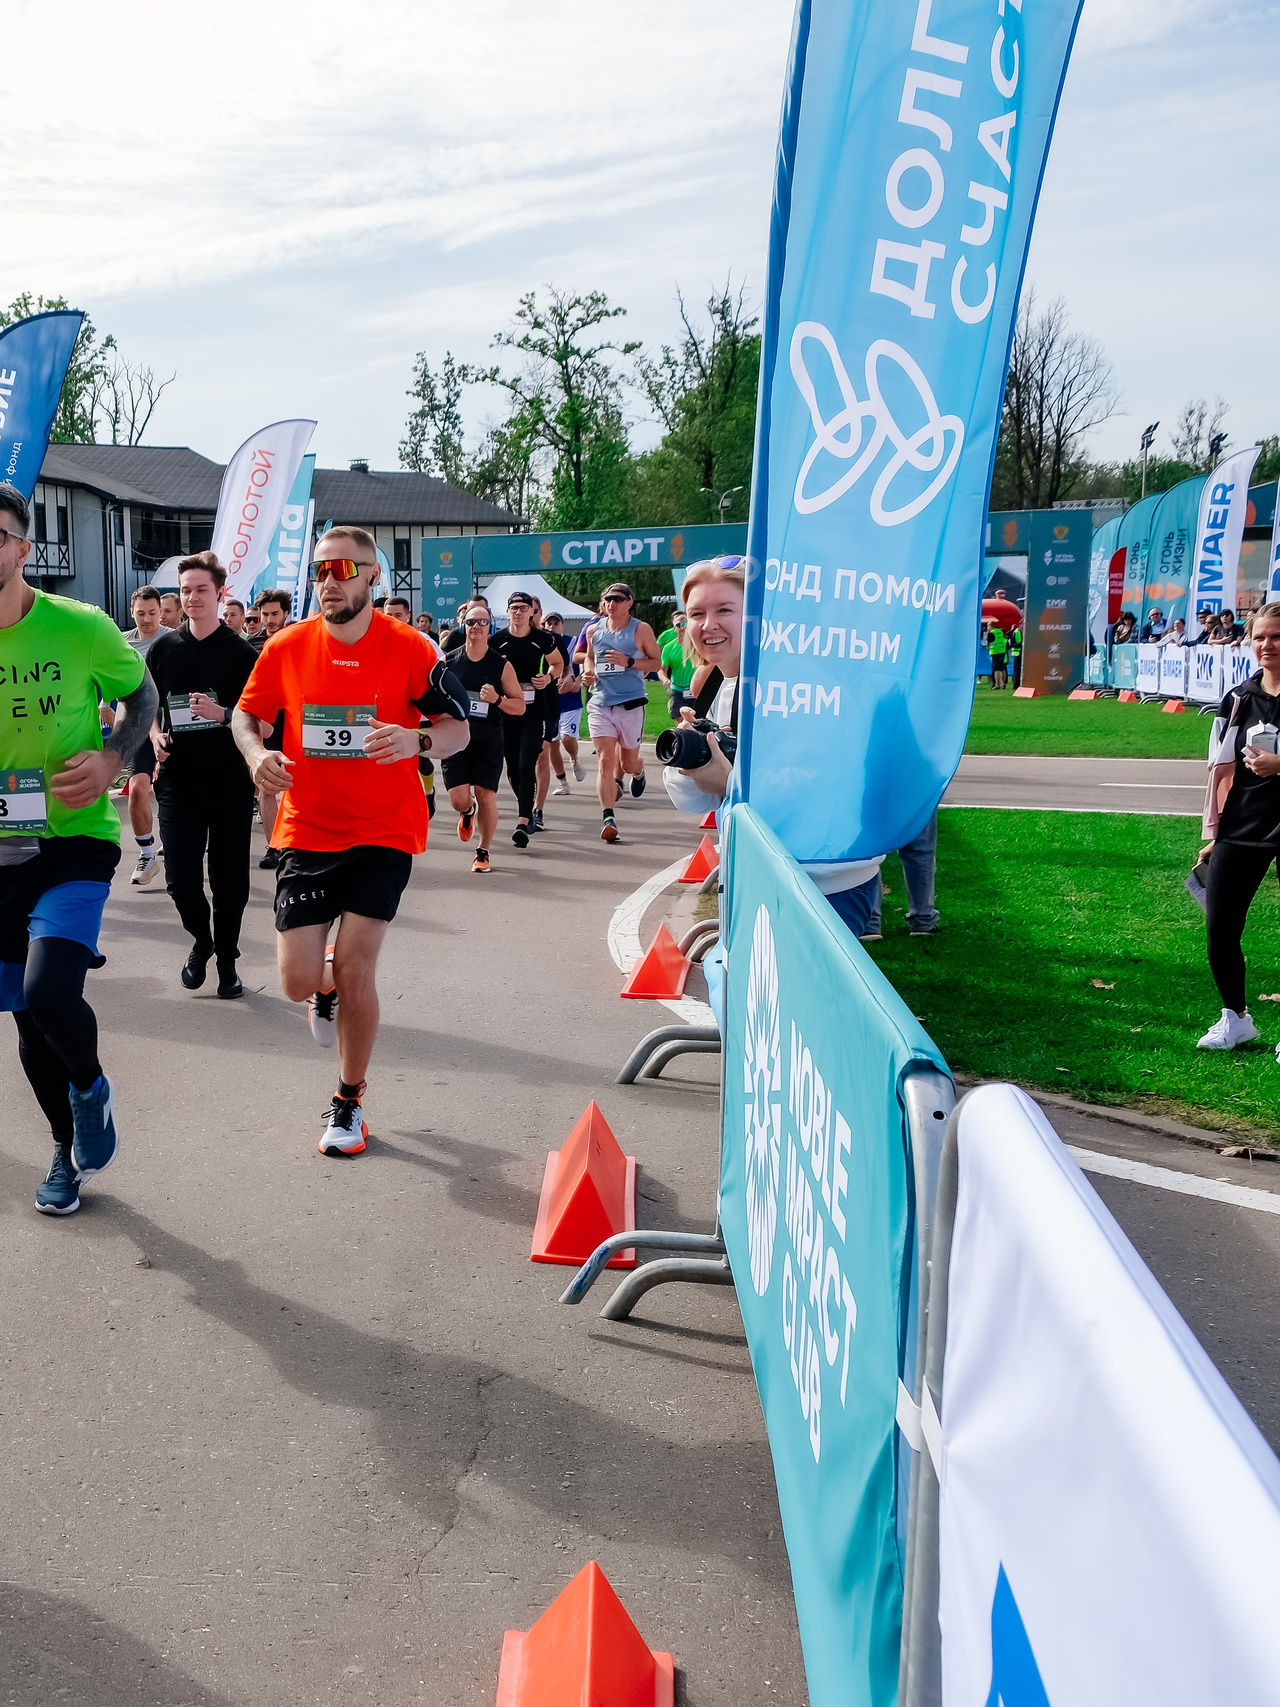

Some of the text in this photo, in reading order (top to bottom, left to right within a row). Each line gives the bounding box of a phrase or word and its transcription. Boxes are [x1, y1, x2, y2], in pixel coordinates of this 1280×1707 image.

[5, 441, 23, 476] фонд
[228, 448, 276, 575] ЗОЛОТОЙ
[562, 537, 665, 566] СТАРТ
[1128, 541, 1141, 579] ОГОНЬ
[1159, 531, 1176, 575] ОГОНЬ
[1170, 528, 1188, 577] ЖИЗНИ
[1197, 482, 1236, 593] MAER
[833, 567, 956, 618] ПОМОЩИ
[604, 663, 616, 671] 28
[324, 729, 352, 747] 39
[570, 723, 578, 734] 9
[788, 1017, 853, 1246] NOBLE
[783, 1130, 858, 1411] IMPACT
[782, 1250, 822, 1465] CLUB
